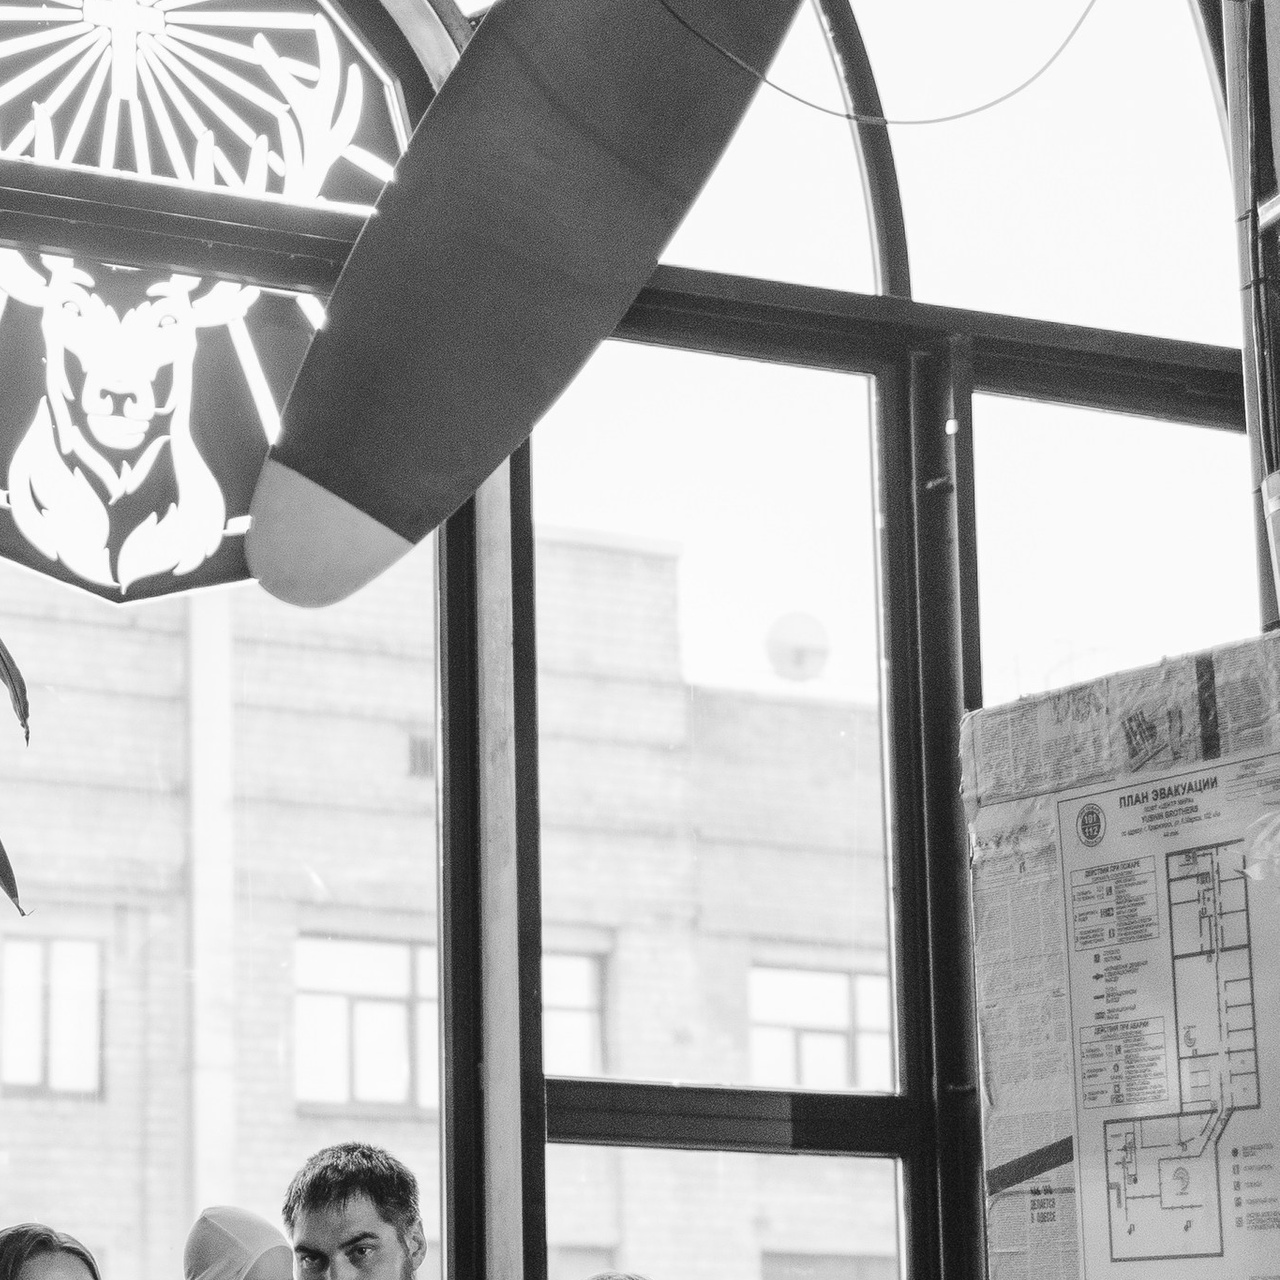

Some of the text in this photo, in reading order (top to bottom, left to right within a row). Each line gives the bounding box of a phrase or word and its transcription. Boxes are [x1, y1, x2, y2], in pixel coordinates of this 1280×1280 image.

[1119, 776, 1219, 809] ПЛАН ЭВАКУАЦИИ
[1083, 812, 1096, 824] 101
[1084, 825, 1098, 836] 112
